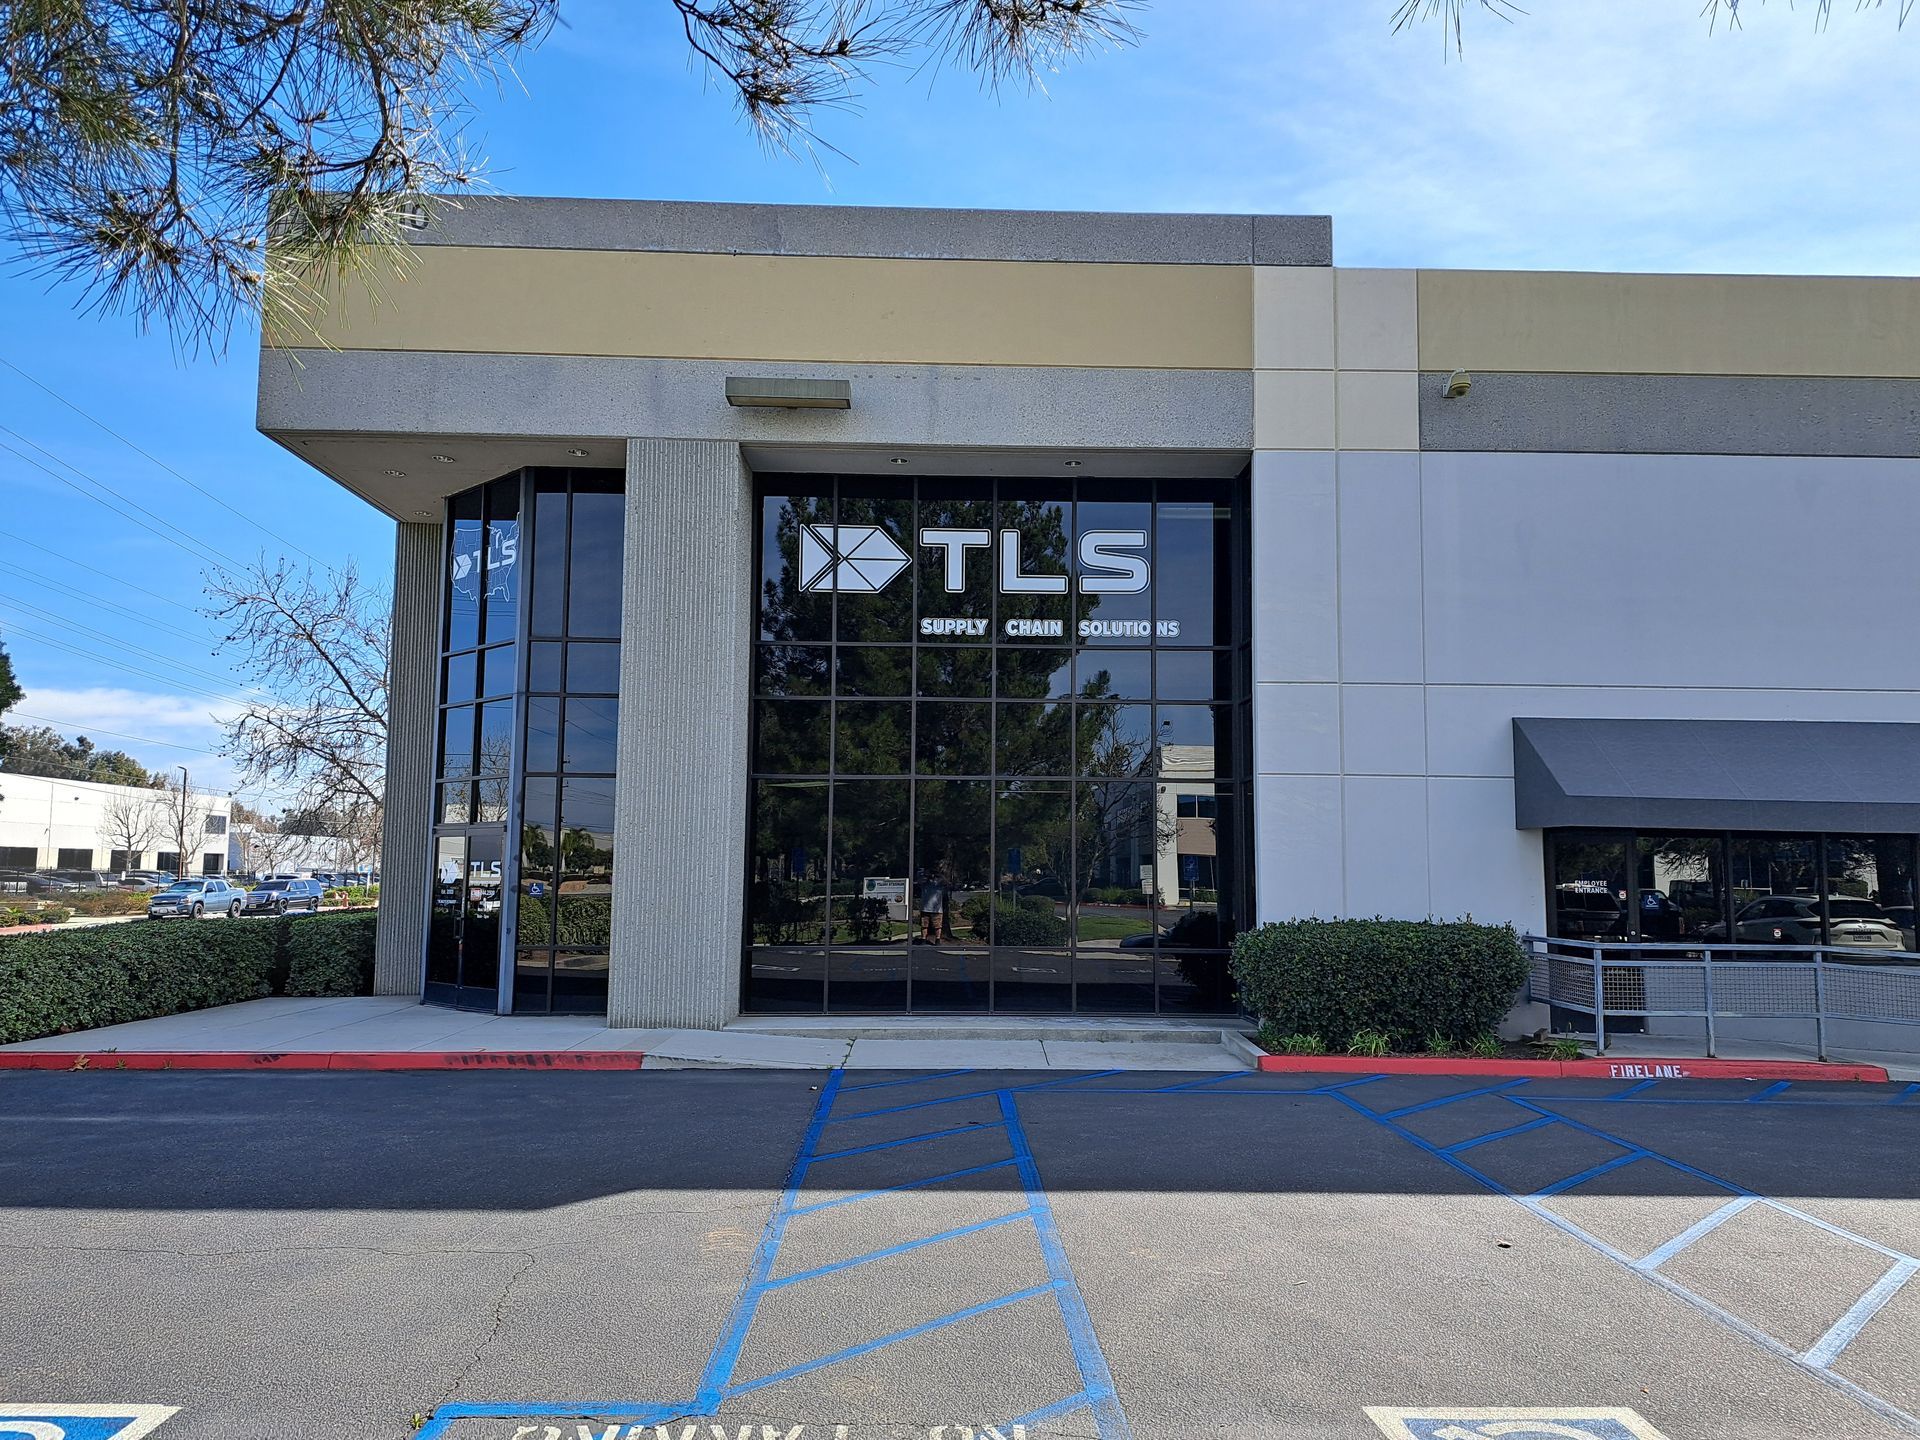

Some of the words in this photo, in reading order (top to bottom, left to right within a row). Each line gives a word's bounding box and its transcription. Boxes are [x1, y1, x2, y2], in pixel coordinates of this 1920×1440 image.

[472, 540, 516, 573] TLS
[919, 528, 1151, 594] TLS
[920, 618, 989, 636] SUPPLY
[1005, 619, 1063, 637] CHAIN
[1078, 619, 1180, 638] SOLUTIONS
[470, 861, 501, 878] TLS
